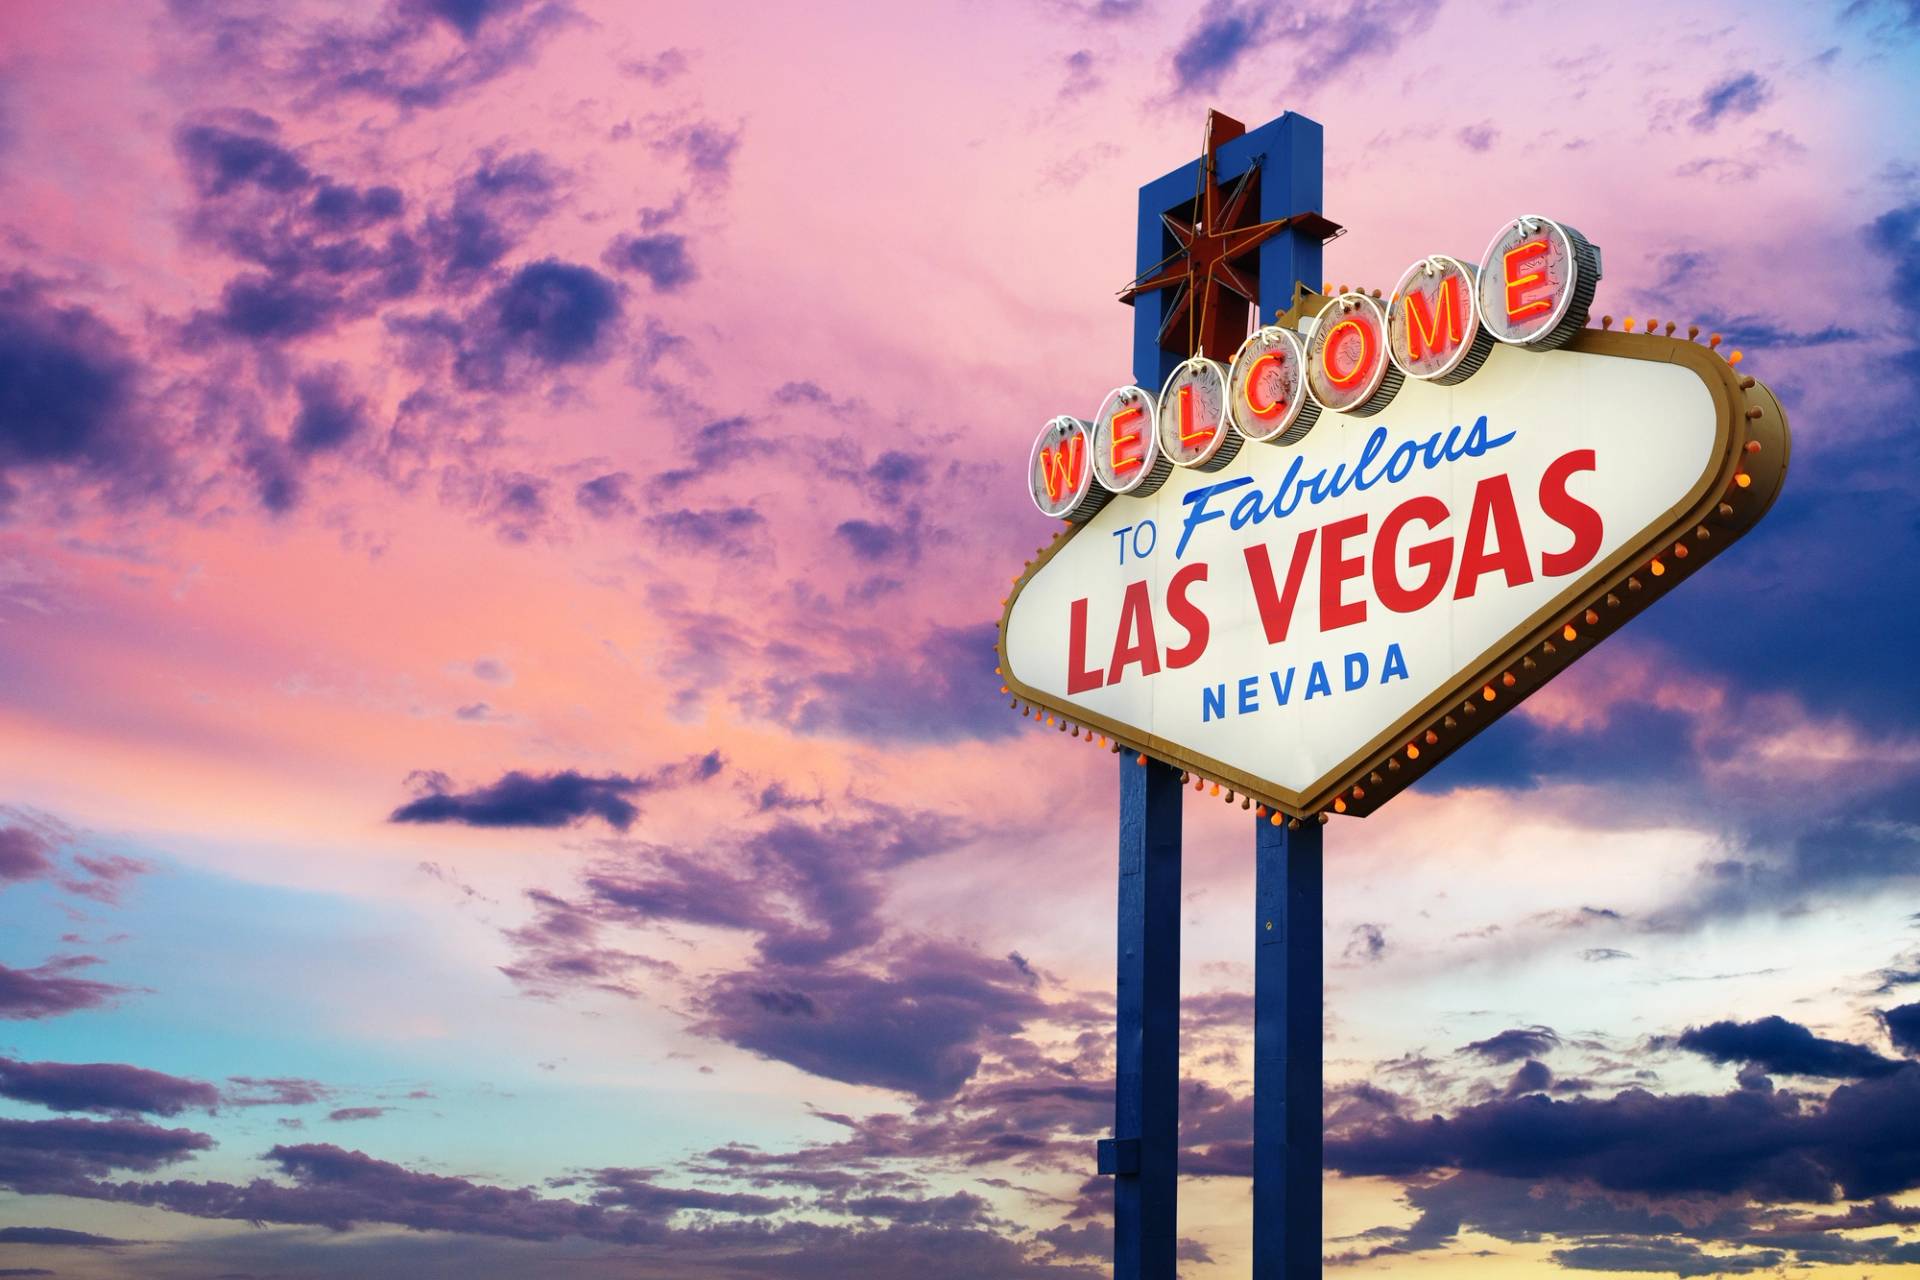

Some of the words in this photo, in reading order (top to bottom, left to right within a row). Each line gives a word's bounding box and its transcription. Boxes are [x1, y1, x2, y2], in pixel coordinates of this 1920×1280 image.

[1040, 238, 1553, 502] WELCOME
[1067, 563, 1210, 695] LAS
[1243, 449, 1603, 645] VEGAS
[1113, 520, 1157, 565] TO
[1176, 415, 1516, 559] Fabulous
[1202, 643, 1409, 722] NEVADA
